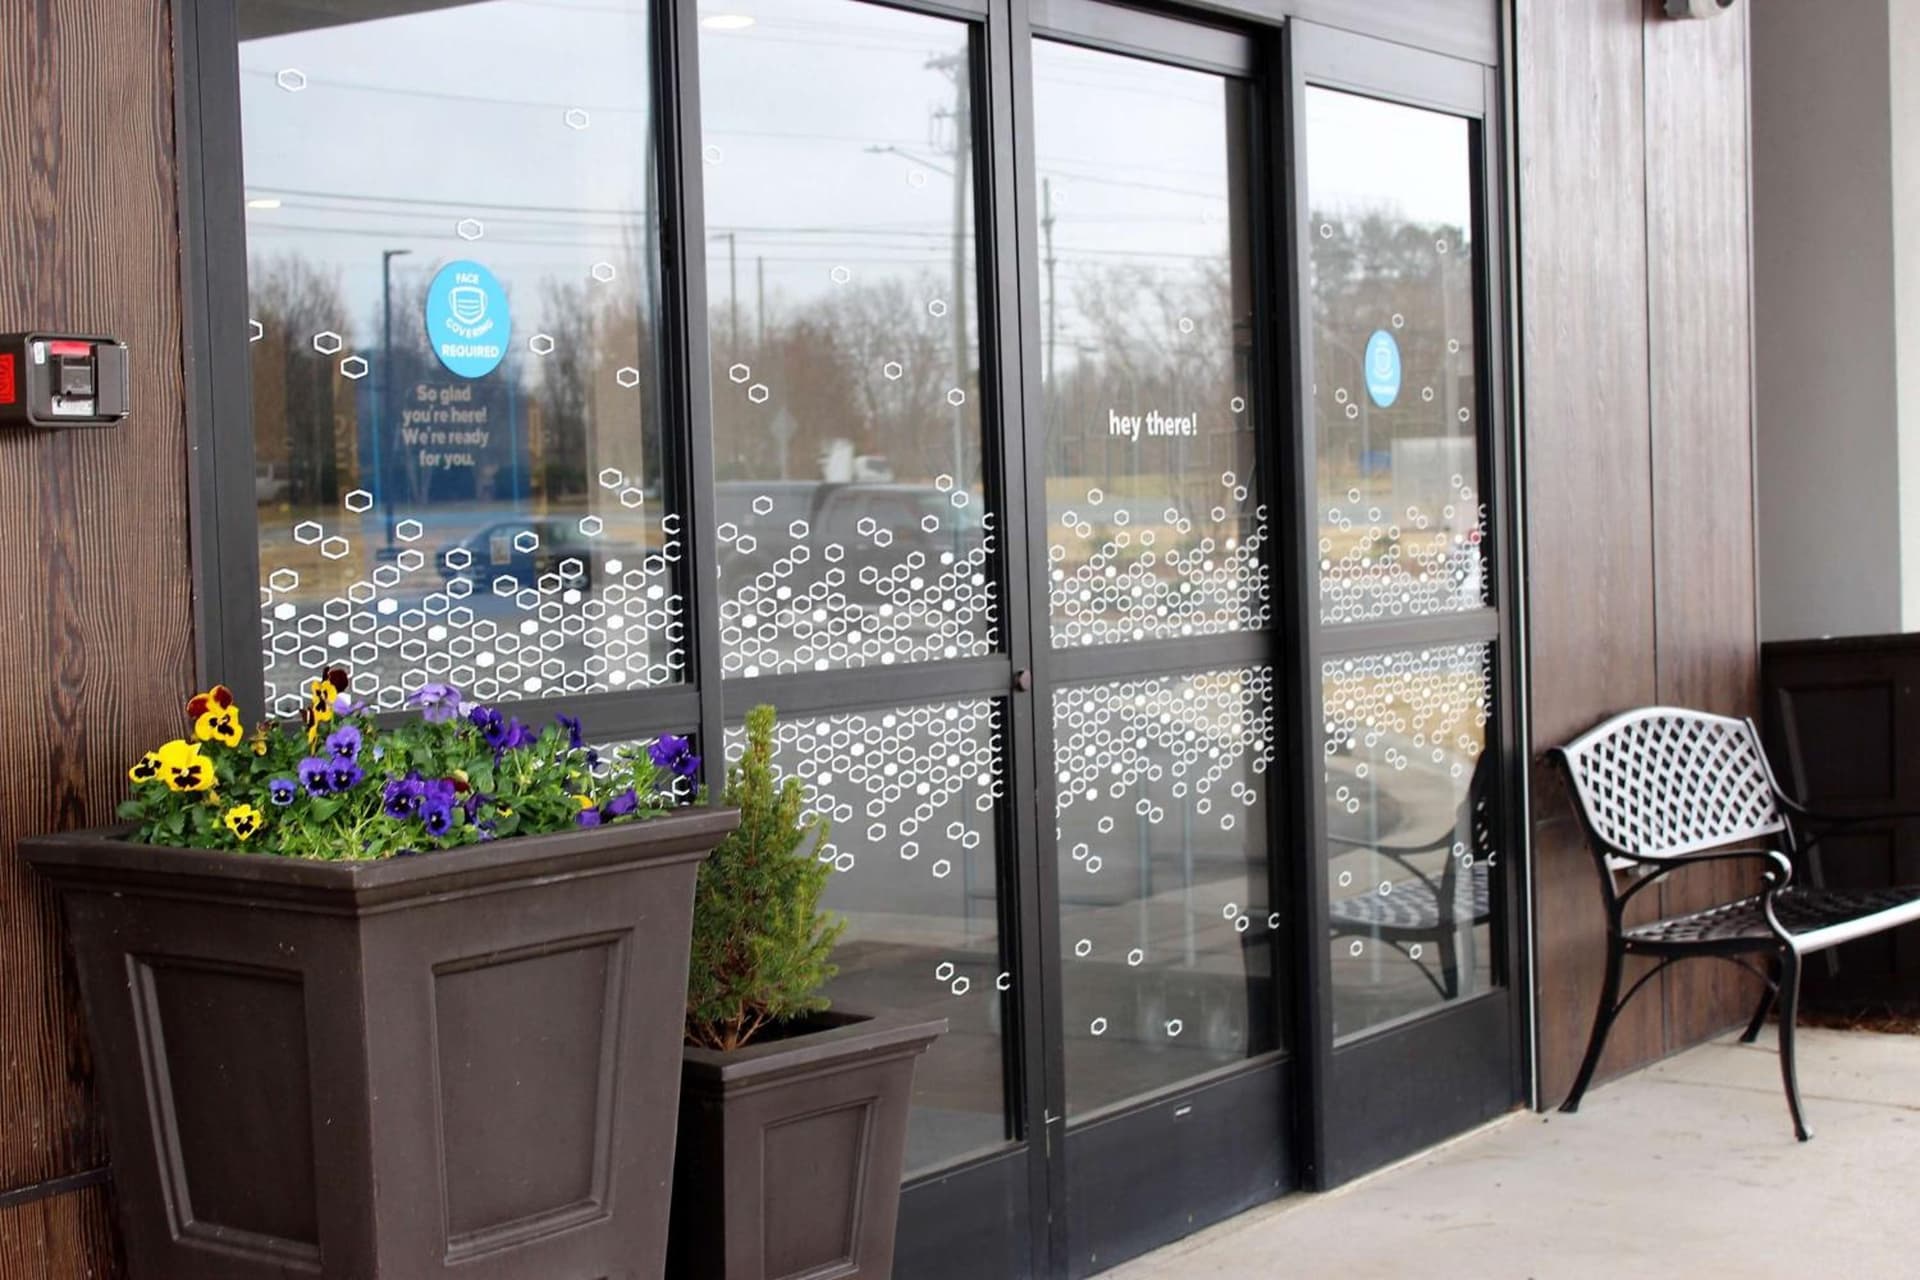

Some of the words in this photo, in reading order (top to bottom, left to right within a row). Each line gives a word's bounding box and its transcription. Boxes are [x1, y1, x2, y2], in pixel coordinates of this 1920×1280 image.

[456, 273, 479, 285] FACE
[441, 344, 499, 358] REQUIRED
[416, 384, 436, 402] So
[440, 385, 471, 405] glad
[403, 405, 448, 426] you're
[451, 407, 487, 424] here!
[1108, 408, 1141, 442] hey
[1145, 409, 1197, 436] there!
[402, 426, 446, 446] We're
[448, 427, 489, 448] ready
[419, 450, 441, 466] for
